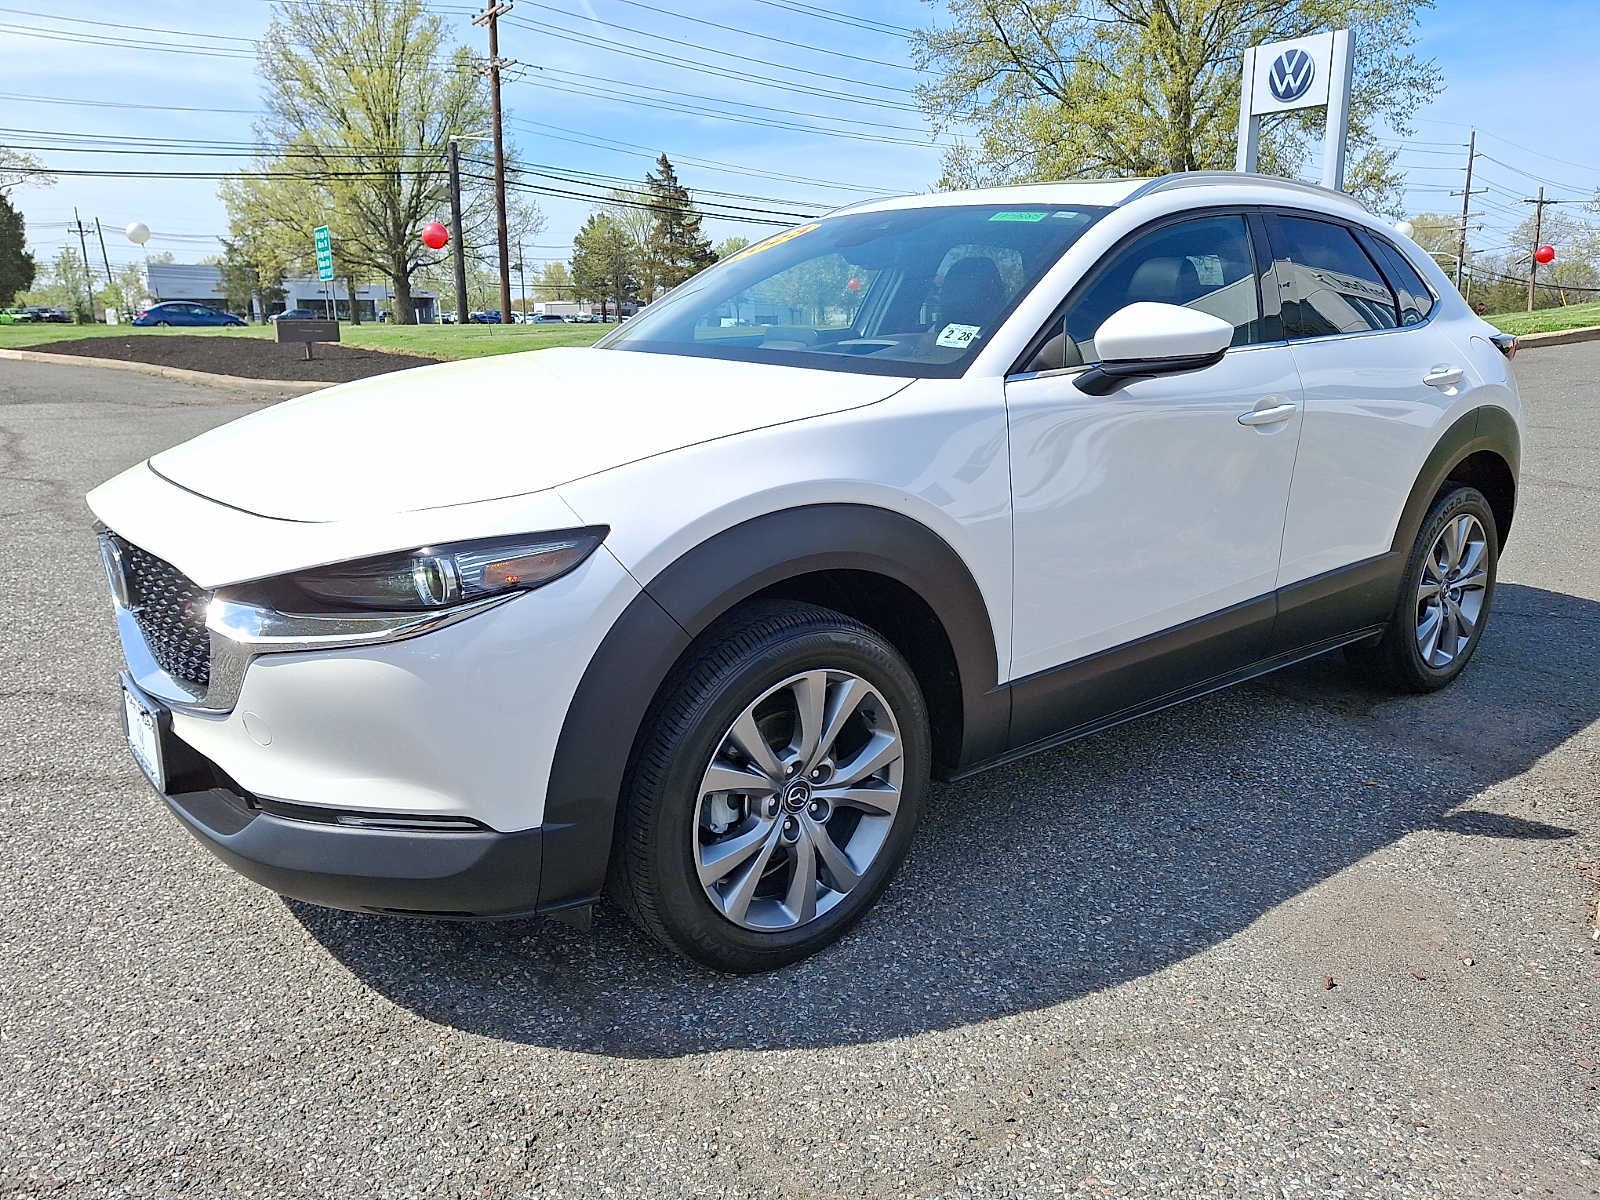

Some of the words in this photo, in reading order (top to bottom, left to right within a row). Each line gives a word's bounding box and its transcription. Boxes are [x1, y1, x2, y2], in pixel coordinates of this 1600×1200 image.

[1270, 49, 1312, 99] VW
[944, 329, 955, 339] 2
[957, 331, 973, 342] 28
